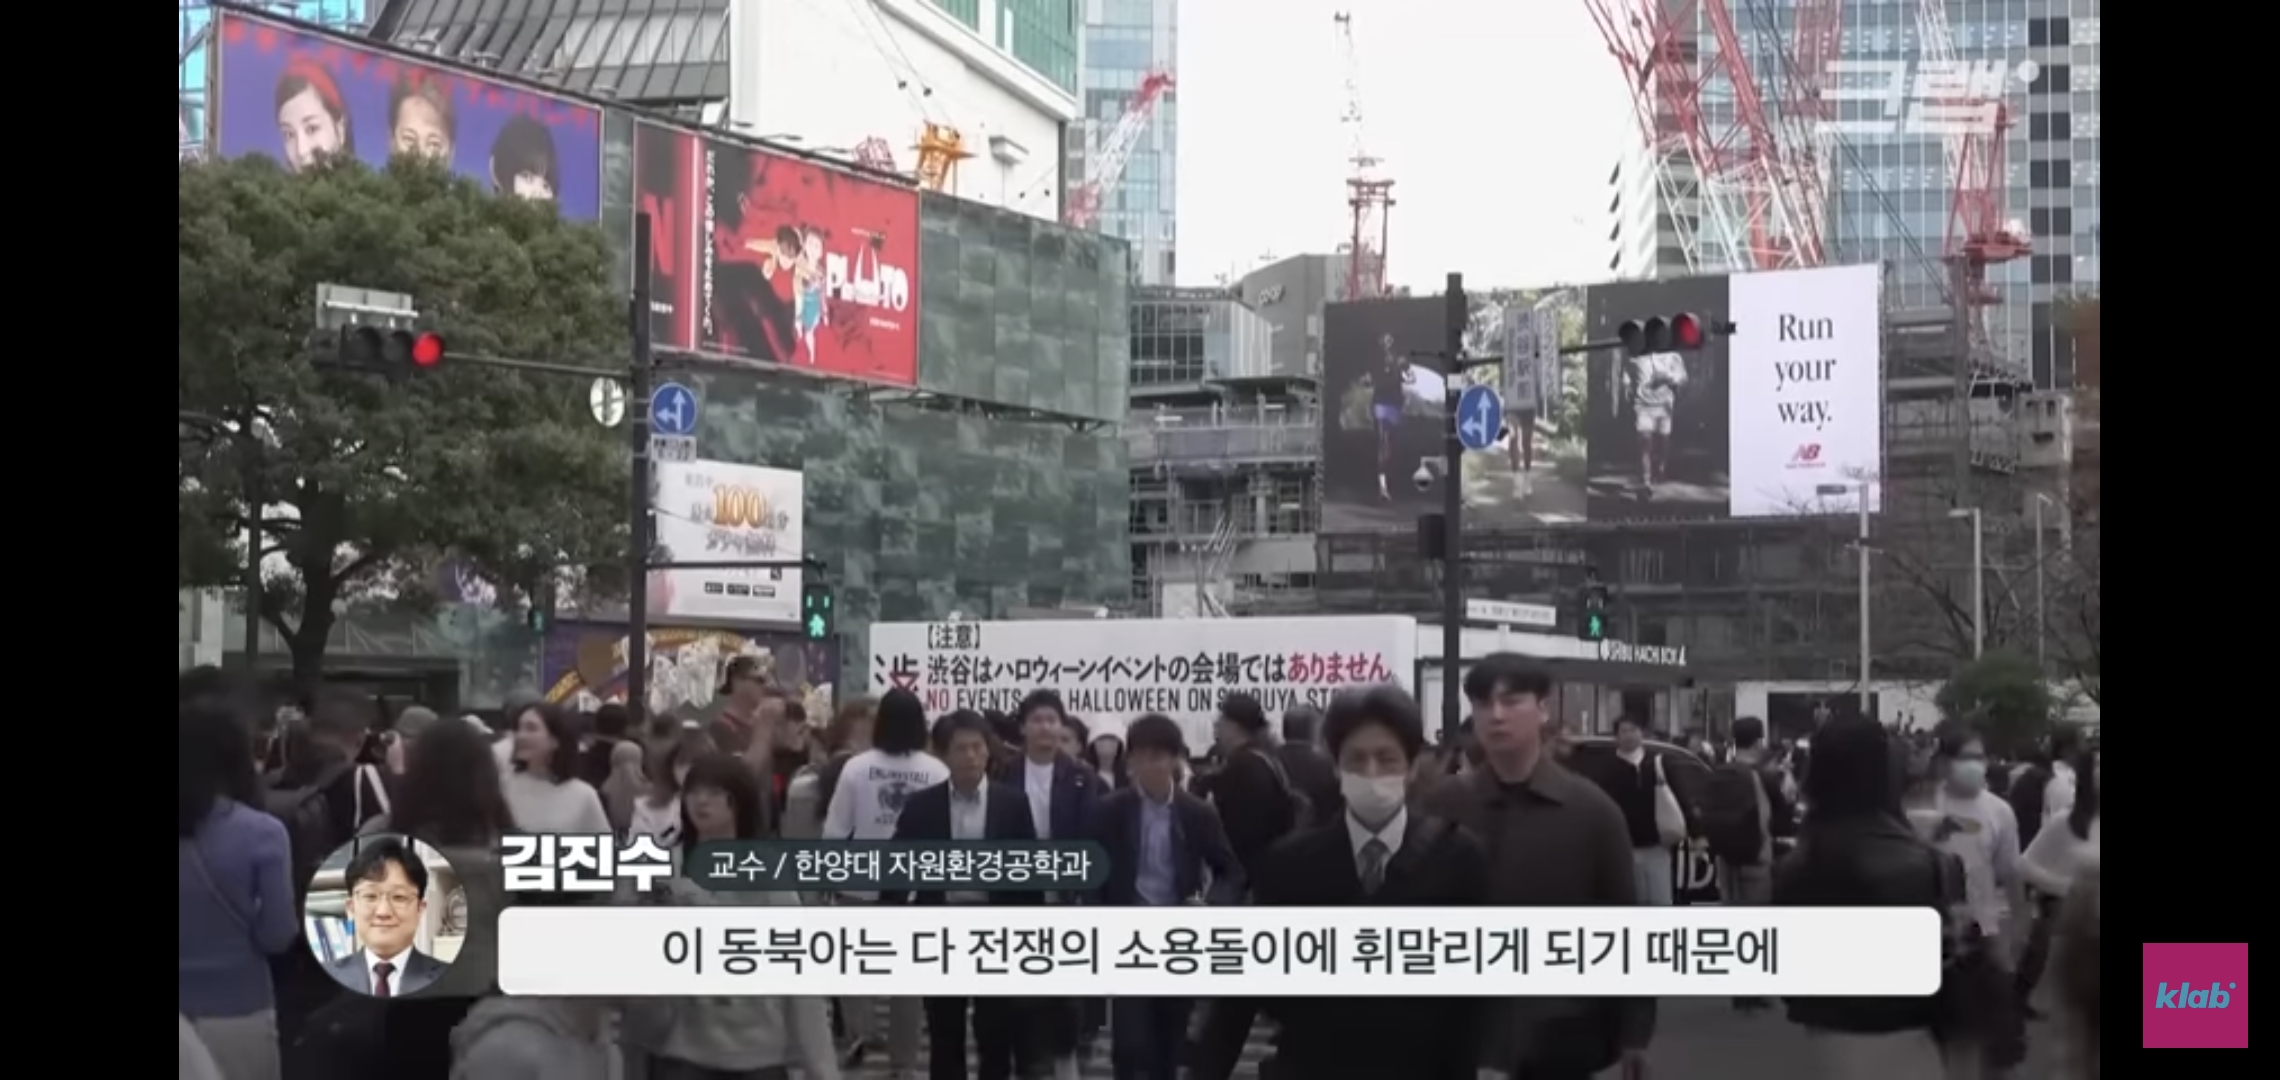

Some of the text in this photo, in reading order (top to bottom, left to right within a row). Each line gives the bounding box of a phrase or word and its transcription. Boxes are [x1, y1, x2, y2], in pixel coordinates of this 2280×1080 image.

[826, 243, 909, 313] PLUTO
[1779, 313, 1834, 341] Run
[1774, 358, 1836, 391] your
[1777, 401, 1832, 431] way.
[928, 624, 981, 650] 【注意】
[926, 688, 950, 712] NO
[1069, 688, 1179, 713] HALLOWEEN
[1188, 687, 1212, 712] ON
